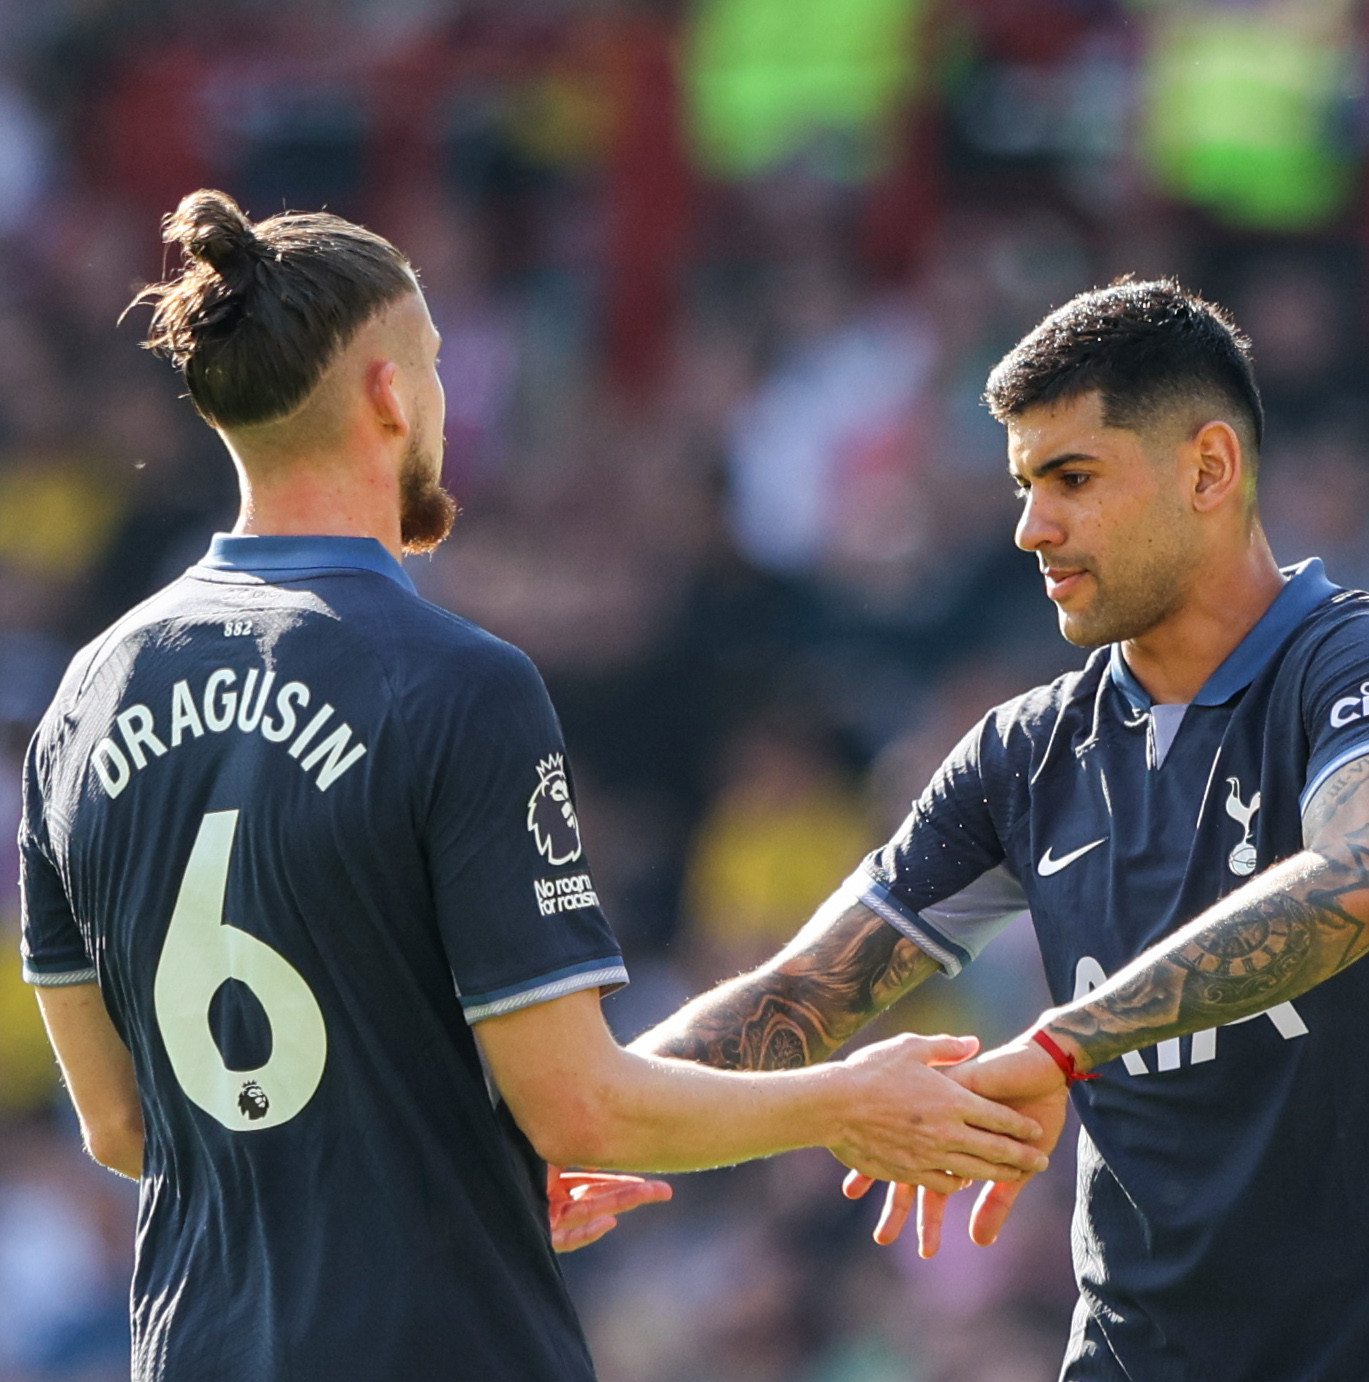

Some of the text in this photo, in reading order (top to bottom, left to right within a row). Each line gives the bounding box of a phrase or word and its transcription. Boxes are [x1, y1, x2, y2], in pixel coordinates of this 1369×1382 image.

[223, 621, 252, 637] 882
[90, 668, 367, 799] DRAGUSIN
[534, 879, 555, 899] No
[538, 898, 555, 916] for
[154, 809, 327, 1132] 6
